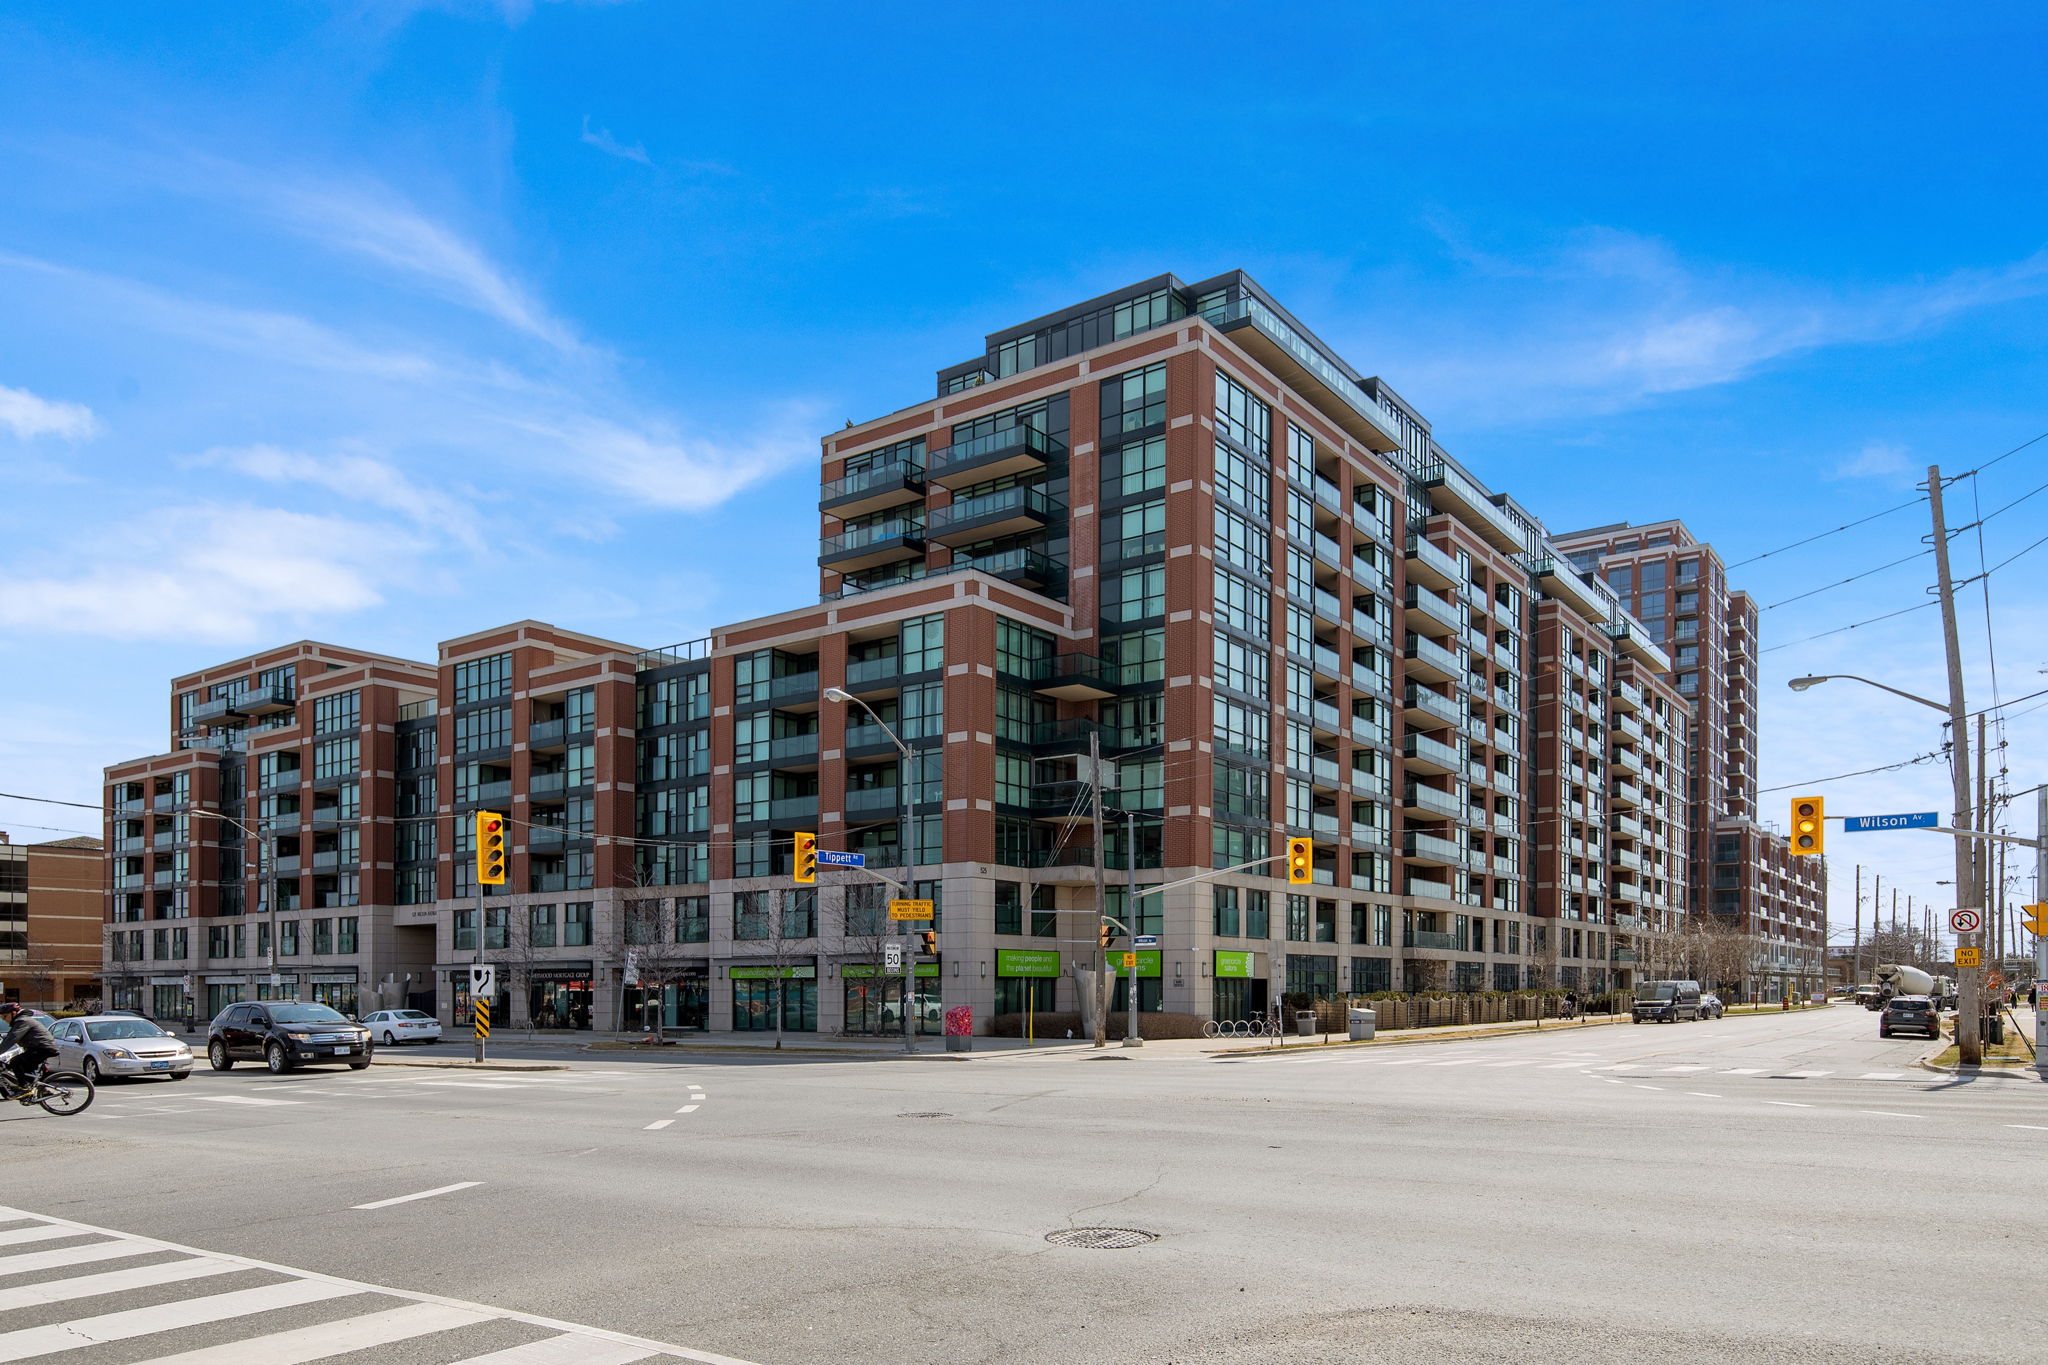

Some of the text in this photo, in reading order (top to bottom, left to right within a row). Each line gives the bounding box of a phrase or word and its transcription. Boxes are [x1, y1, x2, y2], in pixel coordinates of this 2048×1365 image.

[1859, 816, 1908, 828] Wilson
[825, 852, 852, 864] Tippett
[887, 953, 900, 965] 50
[1025, 955, 1042, 963] people
[1958, 957, 1977, 965] EXIT
[1015, 964, 1032, 972] planet
